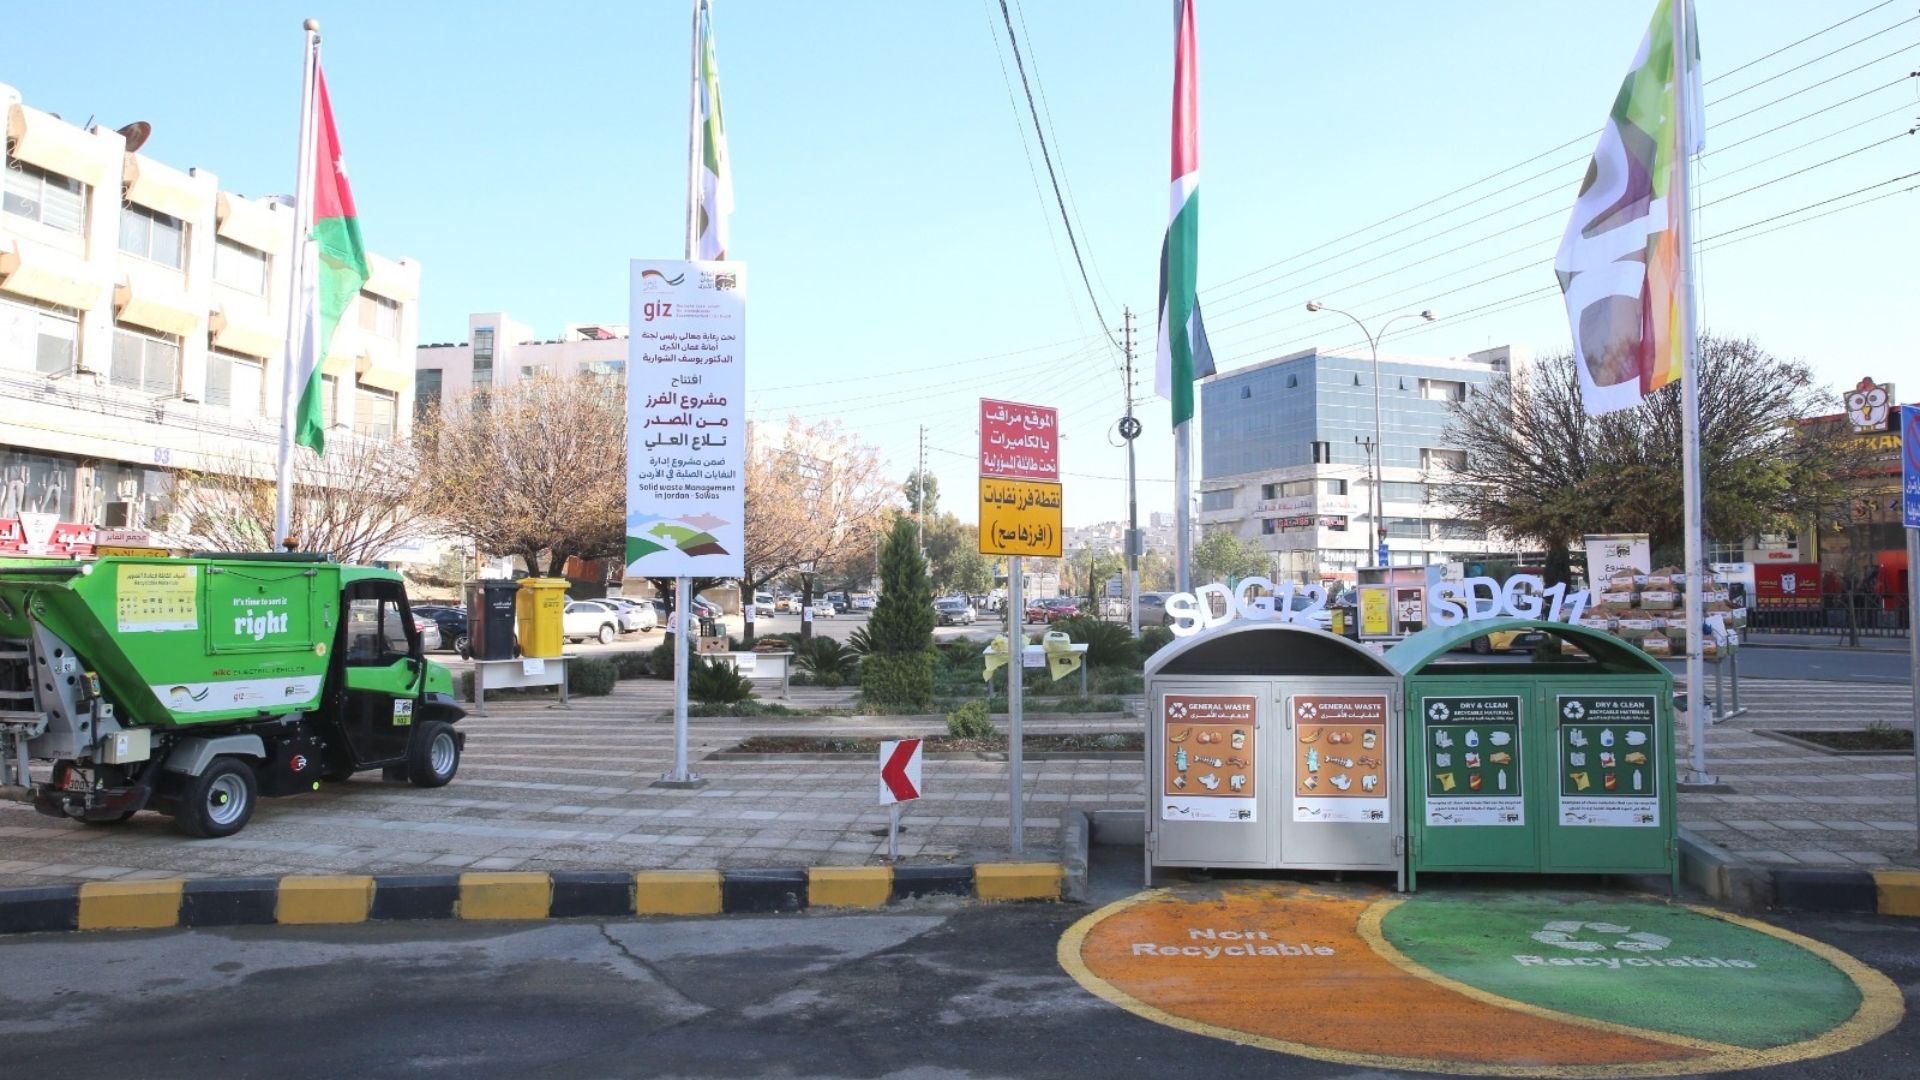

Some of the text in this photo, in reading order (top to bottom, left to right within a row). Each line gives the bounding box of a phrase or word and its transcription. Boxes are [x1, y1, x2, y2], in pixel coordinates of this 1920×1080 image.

[644, 300, 672, 321] giz
[642, 331, 658, 339] لجنة
[660, 332, 677, 340] رئيس
[679, 332, 700, 340] معالي
[703, 332, 719, 341] رعاية
[681, 343, 699, 351] عمان
[701, 342, 718, 351] أمانة
[678, 354, 702, 364] يوسف
[704, 355, 732, 364] الدكتور
[671, 374, 702, 387] افتتاح
[645, 392, 727, 409] مشروع الفرز
[986, 406, 1053, 430] الموقع مراقب
[990, 431, 1050, 453] بالكاميرات
[649, 457, 725, 468] ضمن مشروع إدارة
[1039, 459, 1056, 472] تحت
[639, 468, 736, 481] النفايات الصلبة في الأردن
[684, 484, 735, 492] Management
[984, 485, 1059, 511] نقطة فرز نفايات
[245, 597, 260, 605] time
[1165, 576, 1328, 637] SDG12
[1429, 574, 1590, 627] SDG11
[234, 609, 288, 640] right
[1188, 928, 1271, 940] Non
[1132, 943, 1336, 959] Recyclable
[1511, 954, 1757, 969] Recyclable
